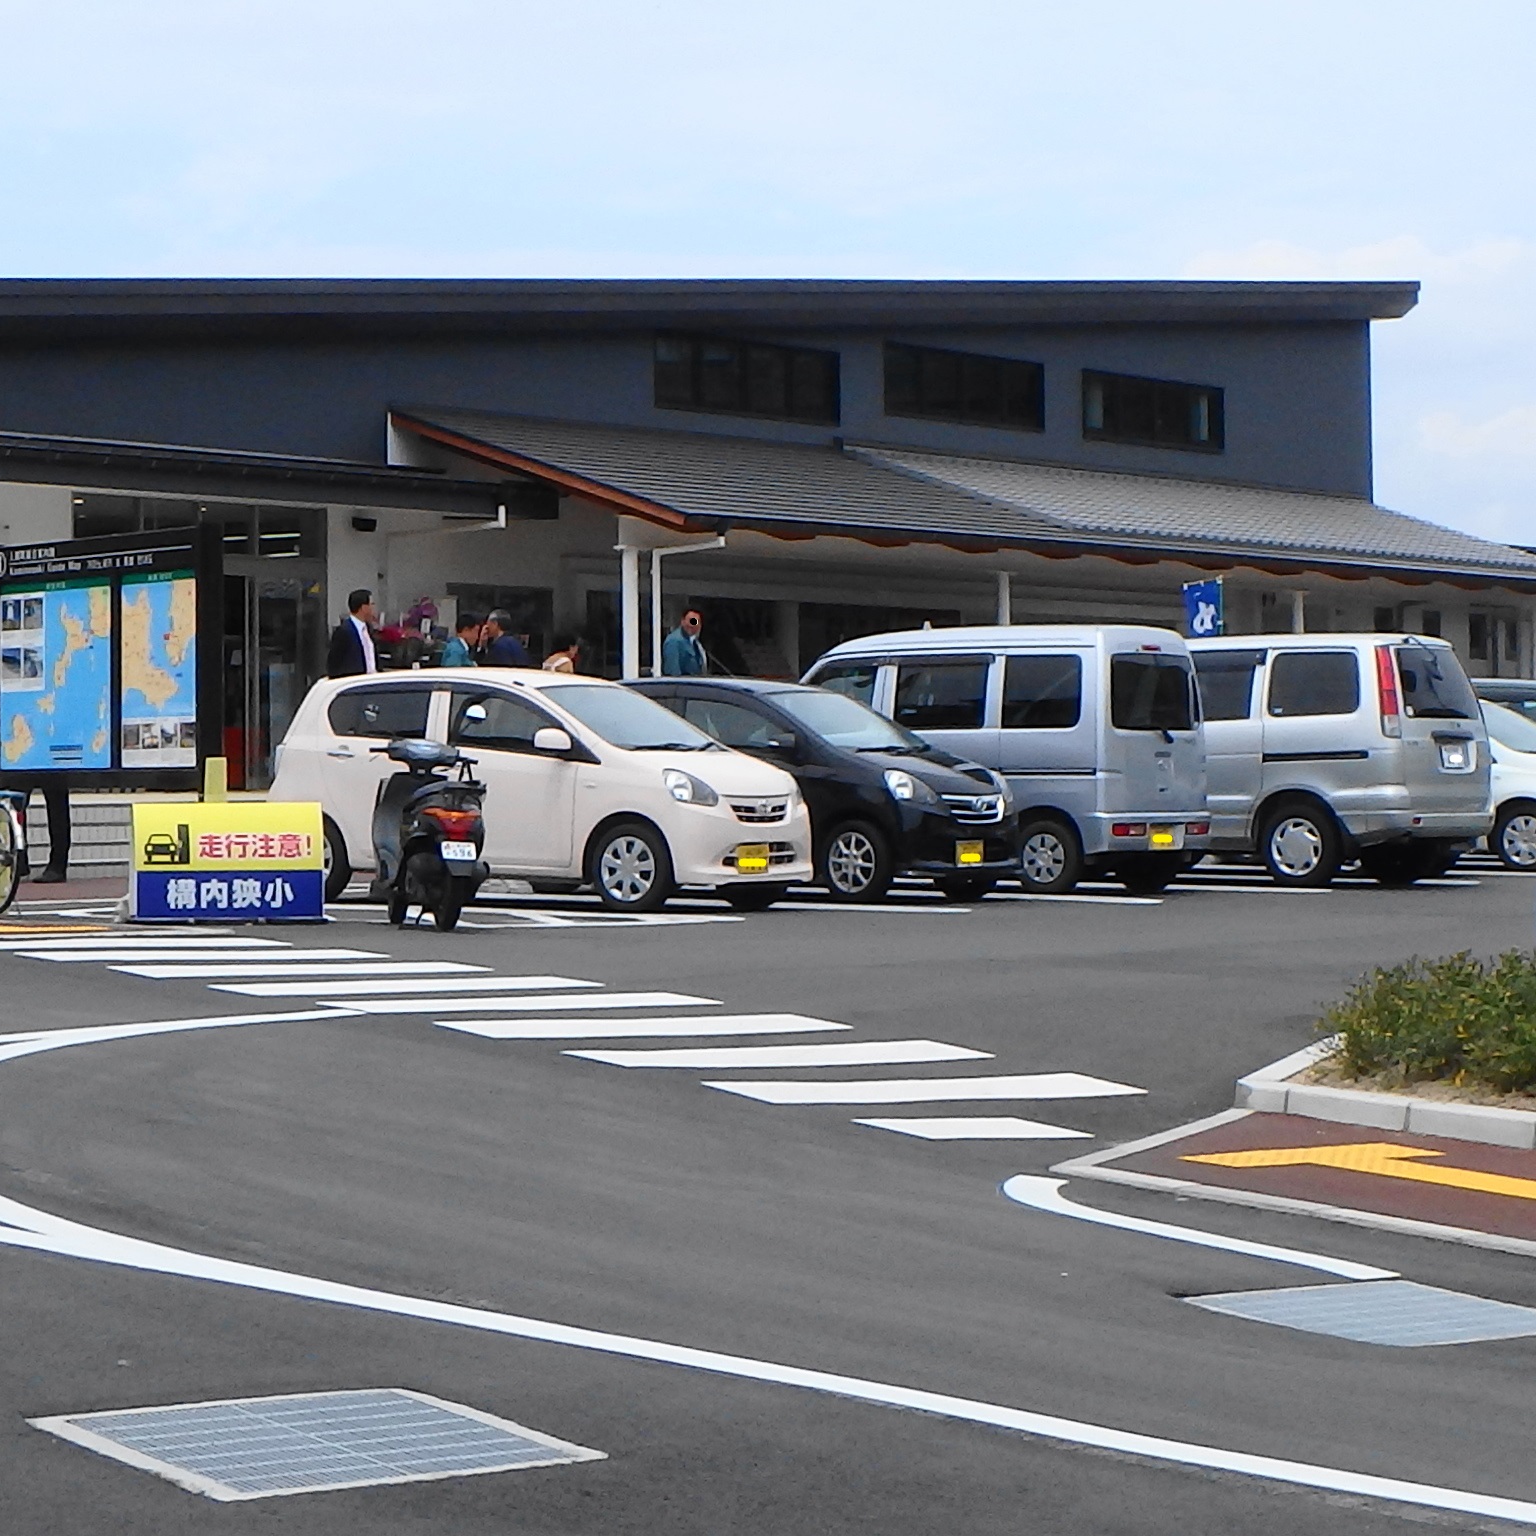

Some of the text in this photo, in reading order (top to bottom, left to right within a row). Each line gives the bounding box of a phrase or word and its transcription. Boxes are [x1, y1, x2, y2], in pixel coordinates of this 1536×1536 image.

[199, 834, 312, 859] 走行注意!
[167, 877, 295, 909] 構内狭小
